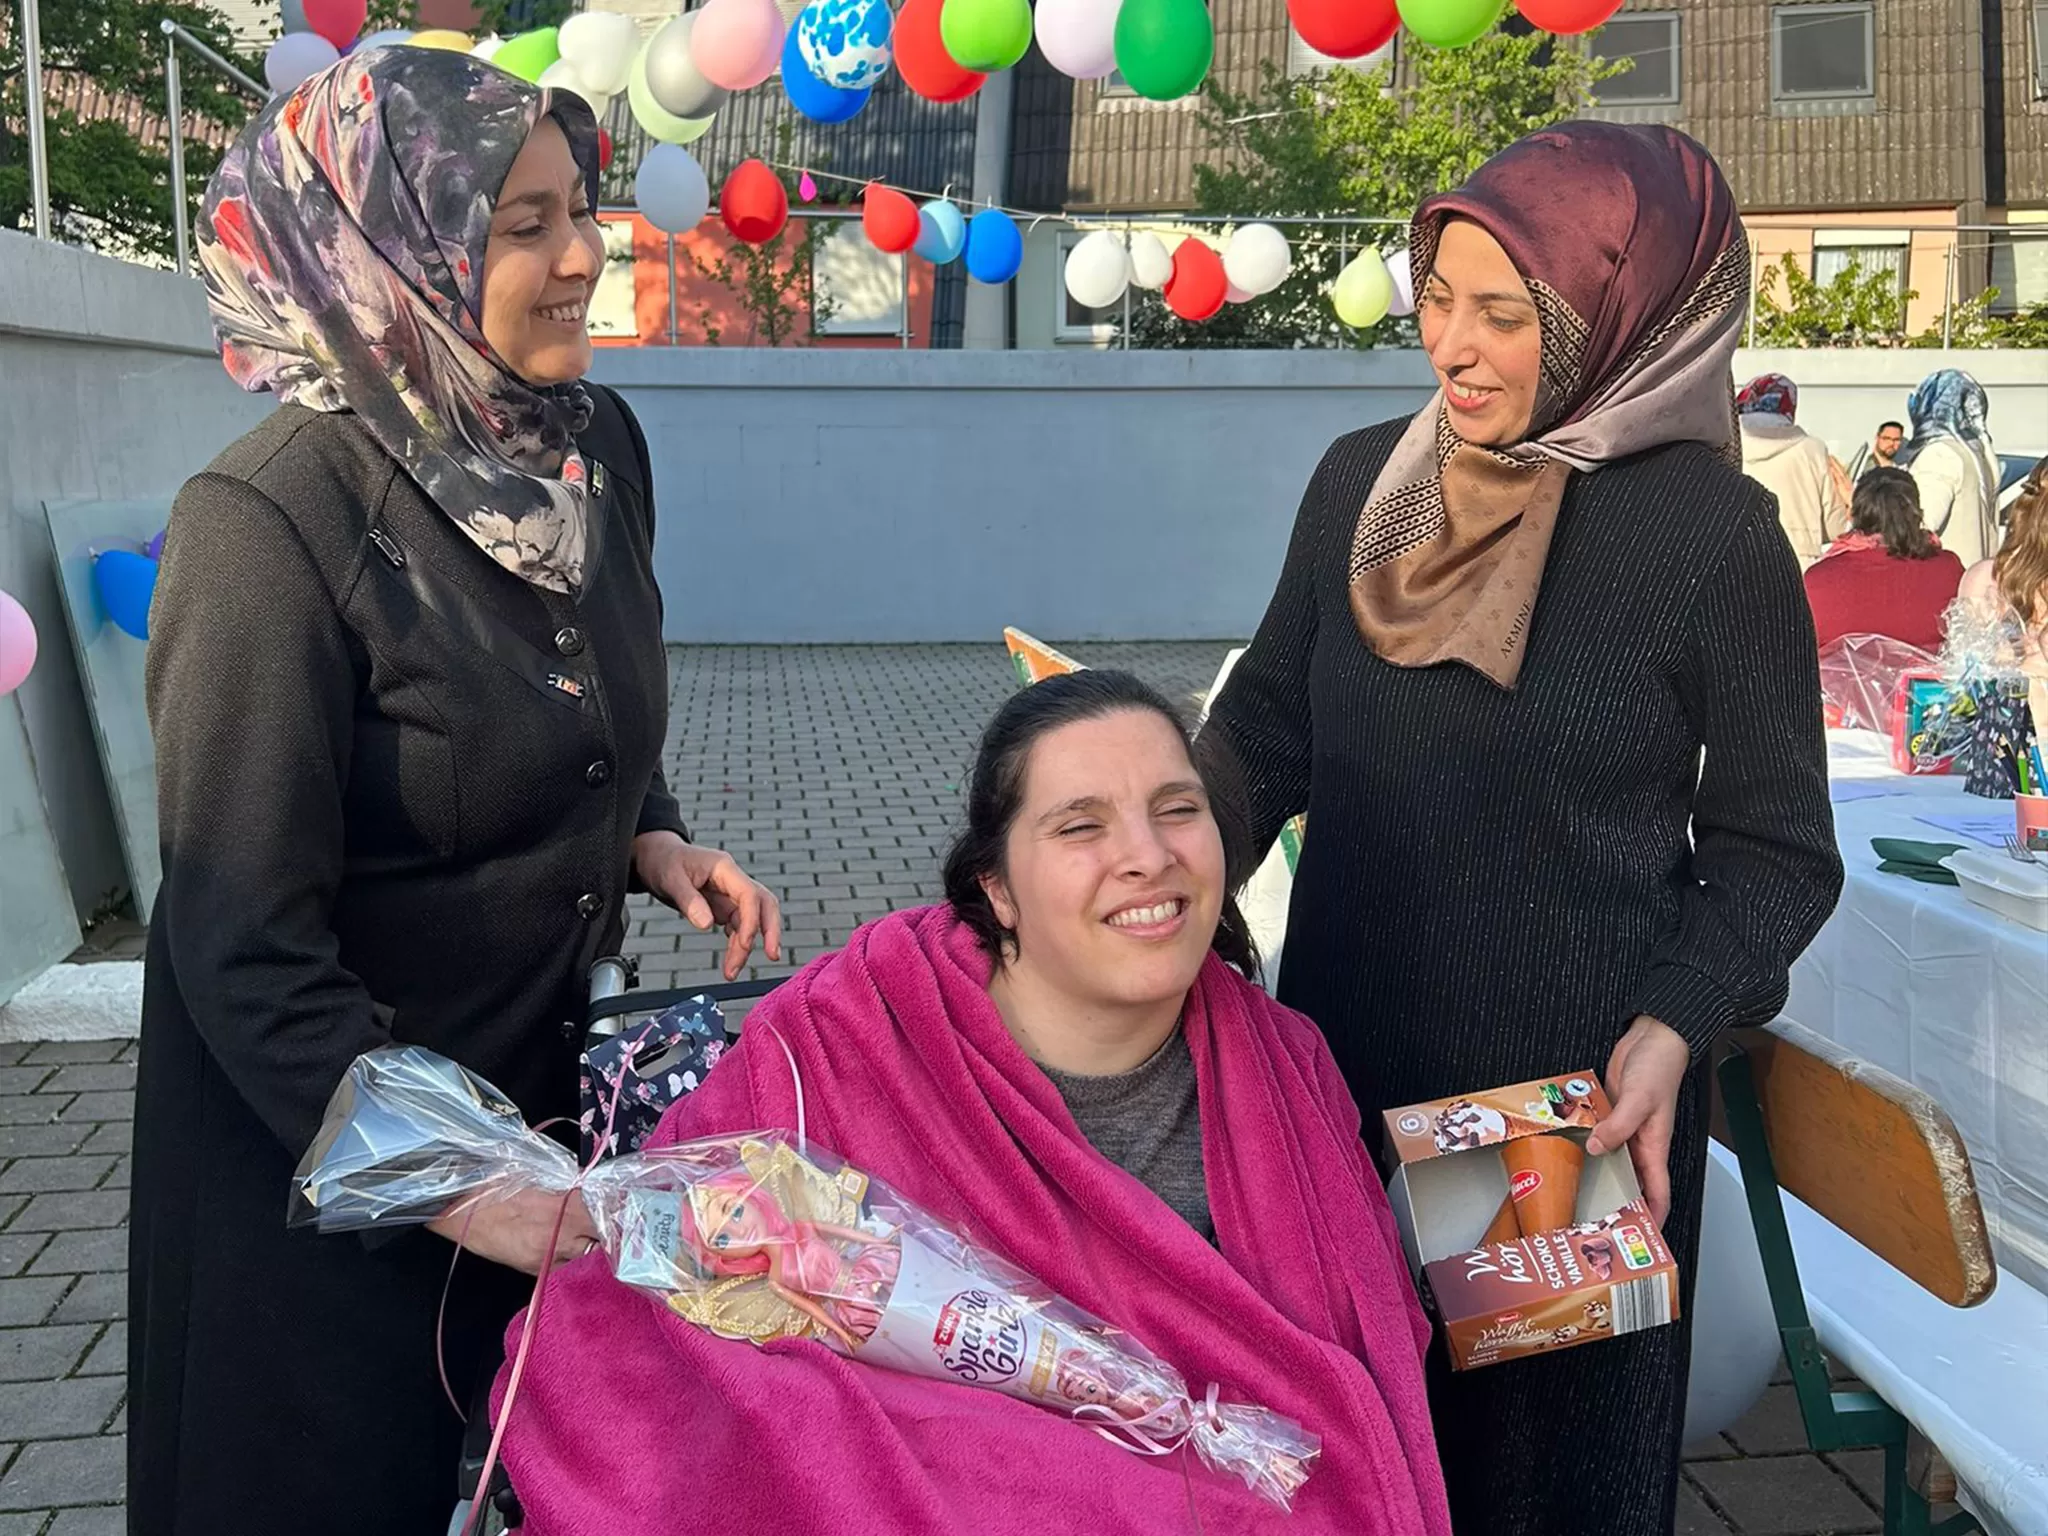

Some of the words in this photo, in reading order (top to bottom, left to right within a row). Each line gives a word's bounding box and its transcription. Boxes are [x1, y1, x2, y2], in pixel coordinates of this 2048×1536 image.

[1552, 1233, 1585, 1286] VANILLE
[938, 1312, 957, 1341] ZURU
[943, 1289, 989, 1382] Sparkle
[981, 1303, 1021, 1376] Girlz
